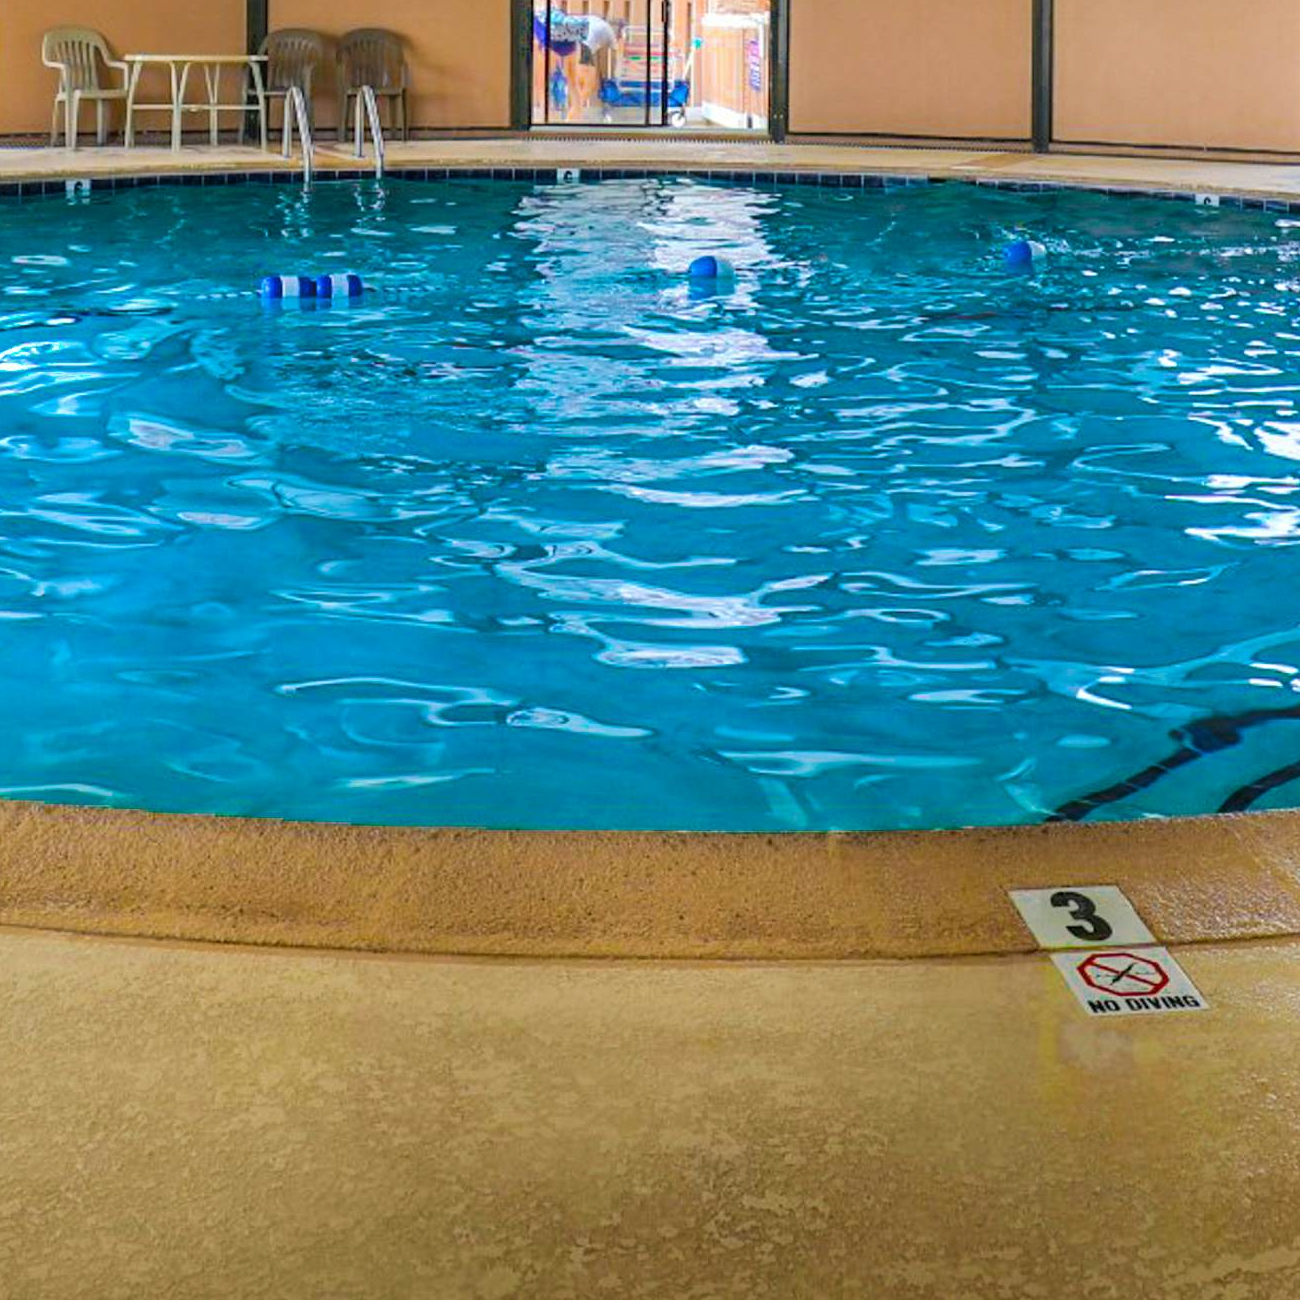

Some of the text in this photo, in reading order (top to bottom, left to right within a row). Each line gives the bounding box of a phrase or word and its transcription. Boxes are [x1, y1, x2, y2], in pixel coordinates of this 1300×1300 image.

[1050, 891, 1113, 941] 3
[1087, 995, 1201, 1014] NO DIVING
